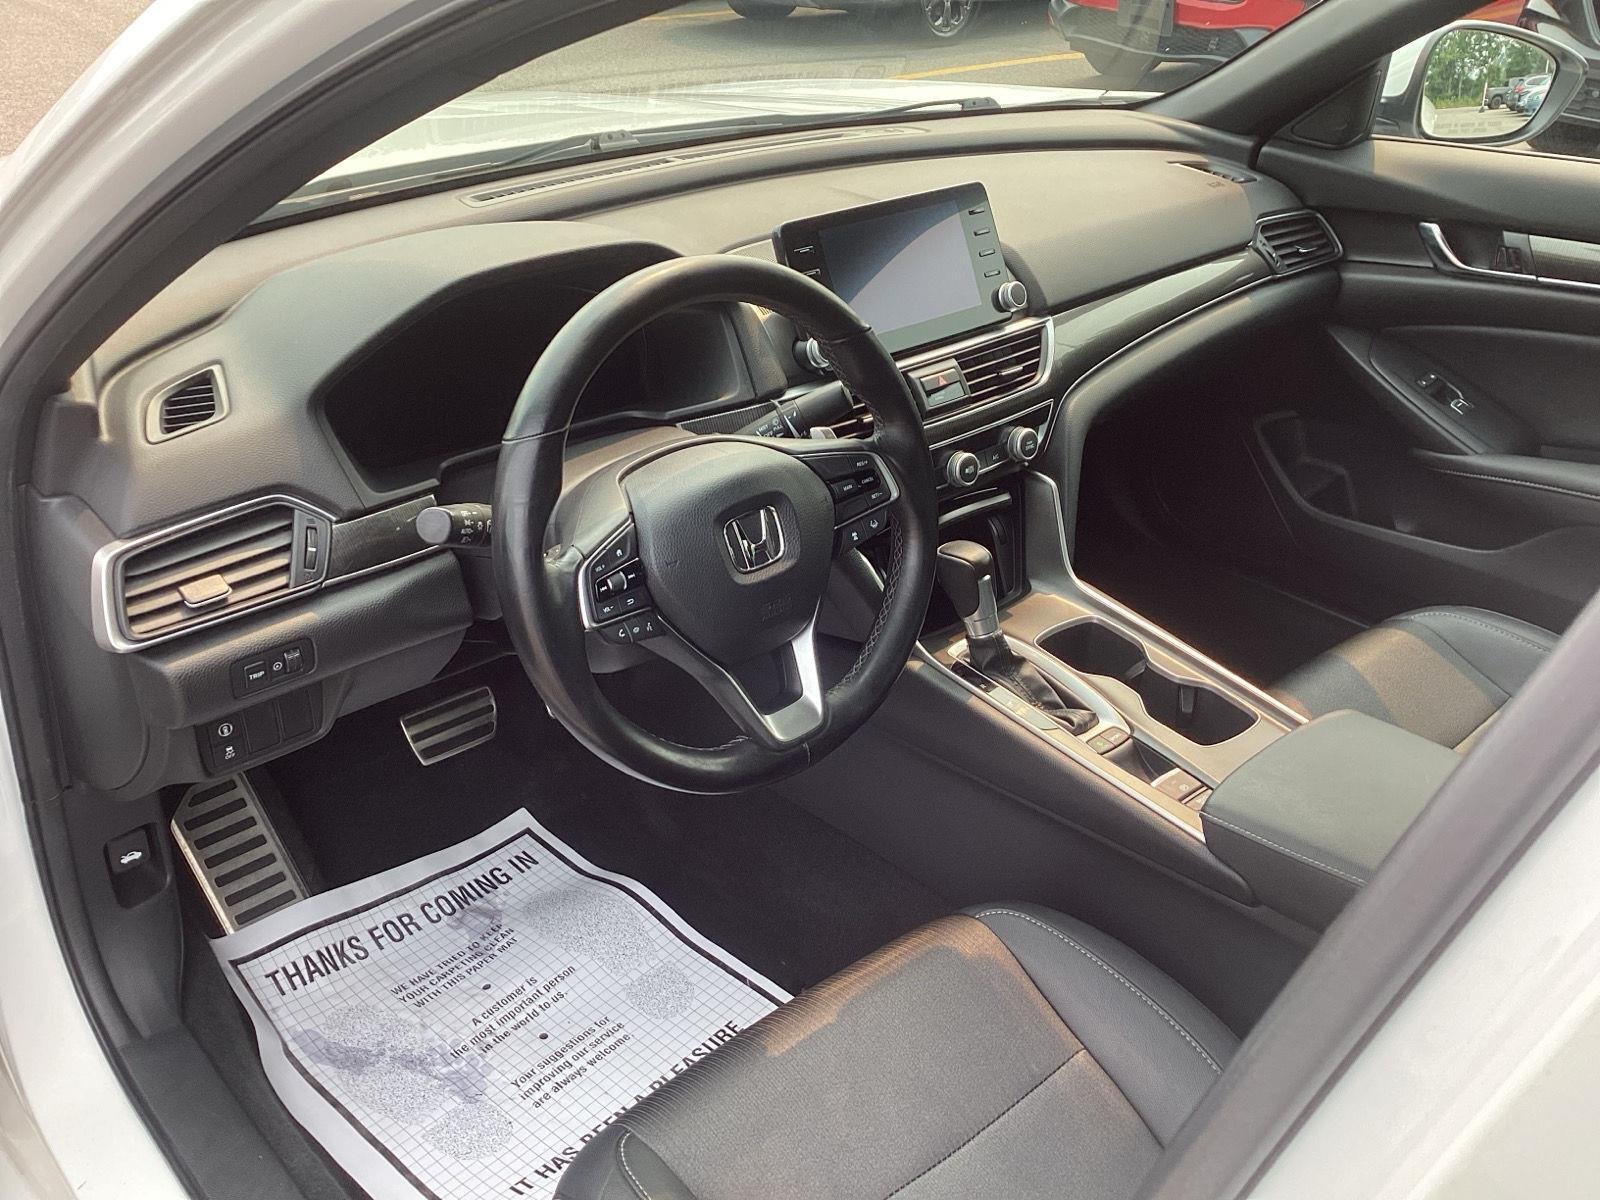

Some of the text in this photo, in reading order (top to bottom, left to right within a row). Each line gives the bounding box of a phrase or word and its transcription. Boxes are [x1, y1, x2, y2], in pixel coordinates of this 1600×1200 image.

[248, 670, 265, 680] TRIP
[264, 850, 539, 997] THANKS FOR COMING IN
[390, 981, 410, 996] WE
[408, 967, 438, 987] HAVE
[436, 949, 467, 972] TRIED
[466, 940, 481, 954] TO
[399, 926, 515, 1005] YOUR CARPETING CLEAN
[412, 936, 519, 1009] WITH THIS PAPER MAT
[449, 965, 577, 1061] the most important person
[471, 975, 539, 1028] A customer is
[479, 1043, 494, 1056] in
[492, 1030, 512, 1046] the
[510, 1008, 541, 1032] world
[537, 1002, 552, 1013] to
[510, 1015, 612, 1091] Your suggestions for
[518, 1021, 626, 1102] improving our service
[531, 1091, 553, 1110] are
[550, 1064, 589, 1096] always
[508, 1176, 535, 1197] IT
